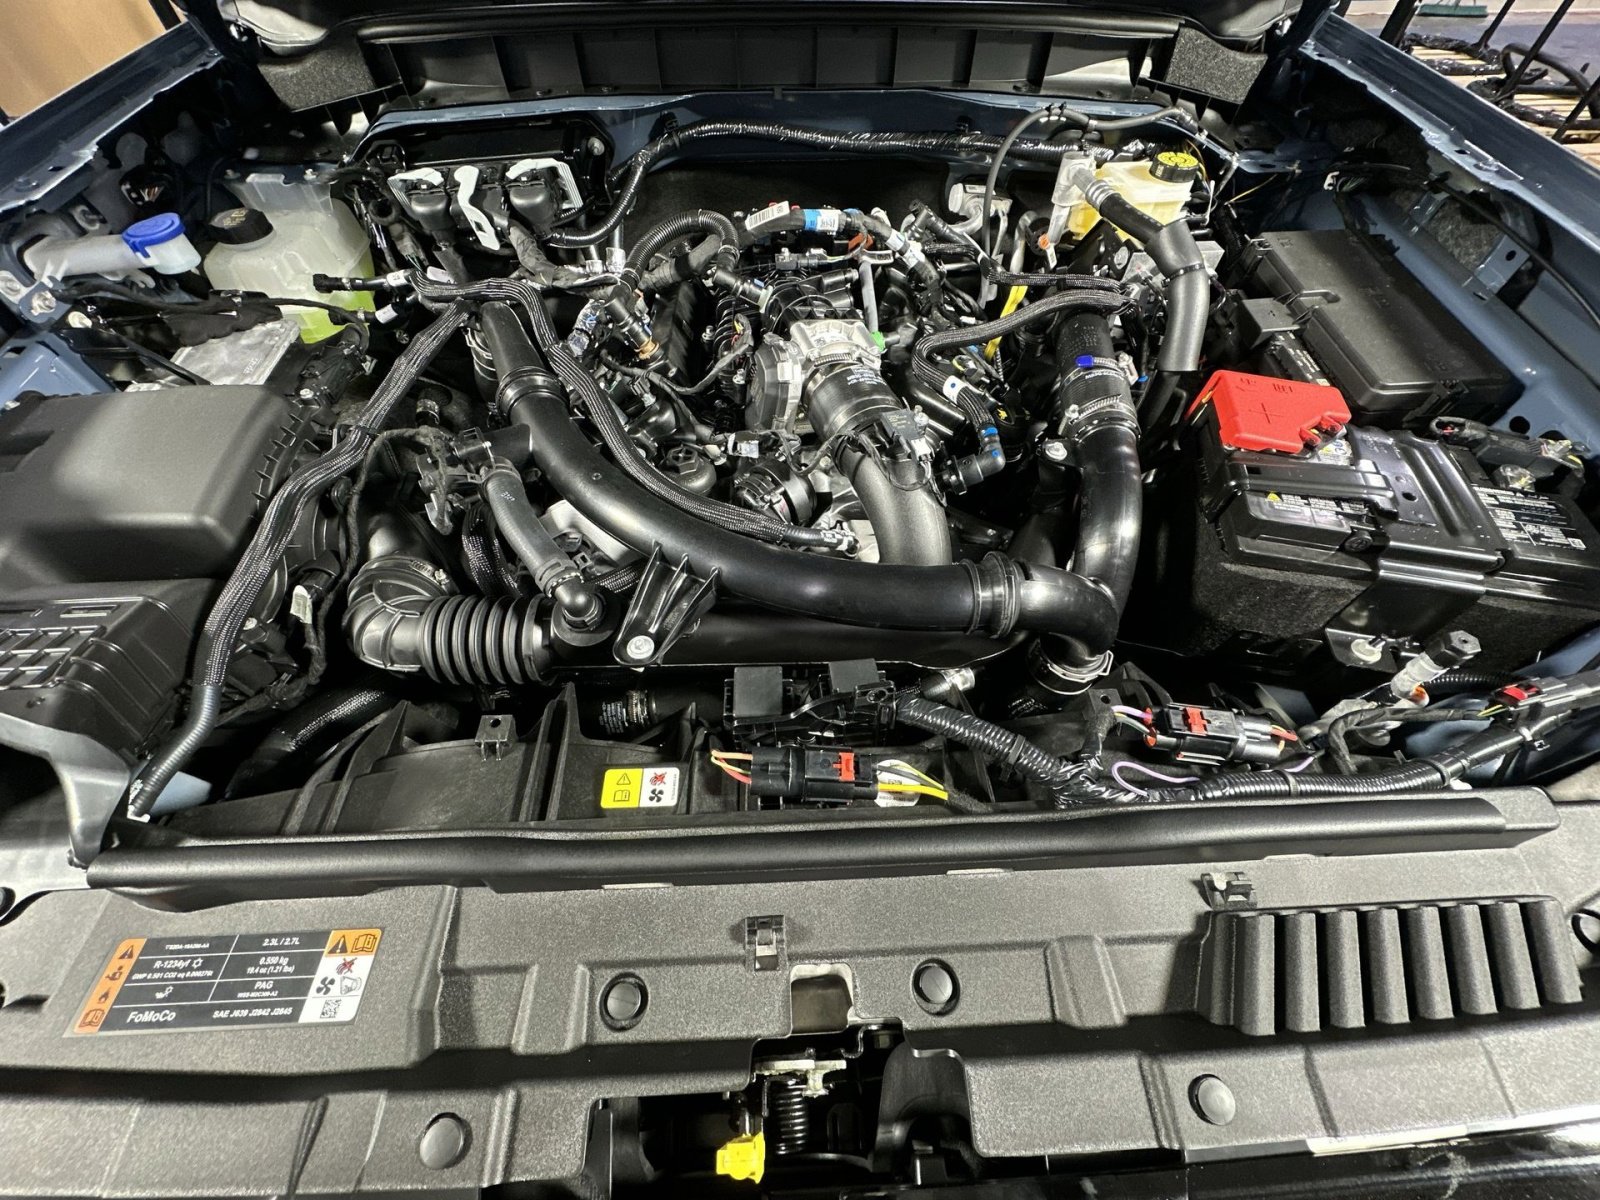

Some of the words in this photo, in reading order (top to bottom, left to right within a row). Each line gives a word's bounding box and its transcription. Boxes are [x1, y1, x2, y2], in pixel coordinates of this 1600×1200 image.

[262, 938, 279, 947] 2.3L
[284, 937, 300, 946] 2.7L
[153, 959, 191, 970] R-1234yf
[279, 956, 289, 965] kg
[254, 980, 274, 990] PAG
[126, 1009, 177, 1023] FoMoCo
[212, 1010, 230, 1018] SAE
